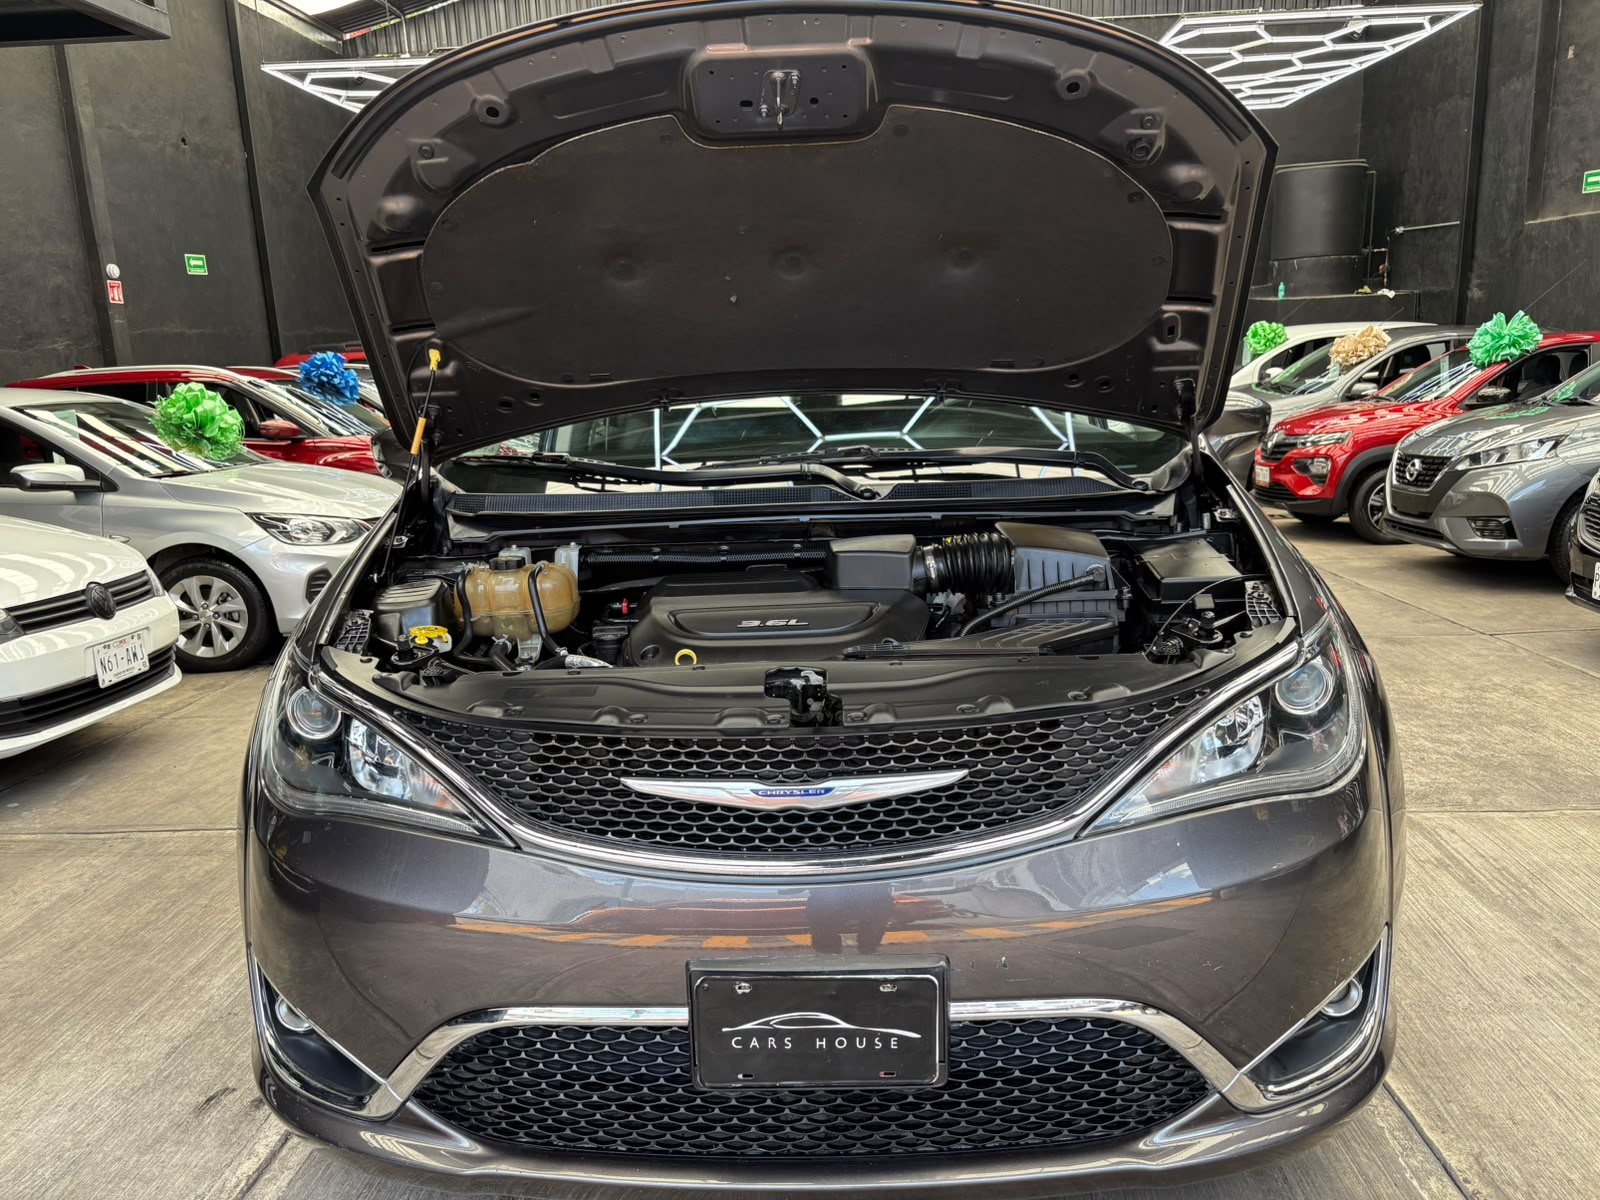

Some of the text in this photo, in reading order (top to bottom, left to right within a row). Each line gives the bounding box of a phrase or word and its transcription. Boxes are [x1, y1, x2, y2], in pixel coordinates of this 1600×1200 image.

[736, 619, 809, 628] 3.6L
[731, 1036, 898, 1049] CARS HOUSE
